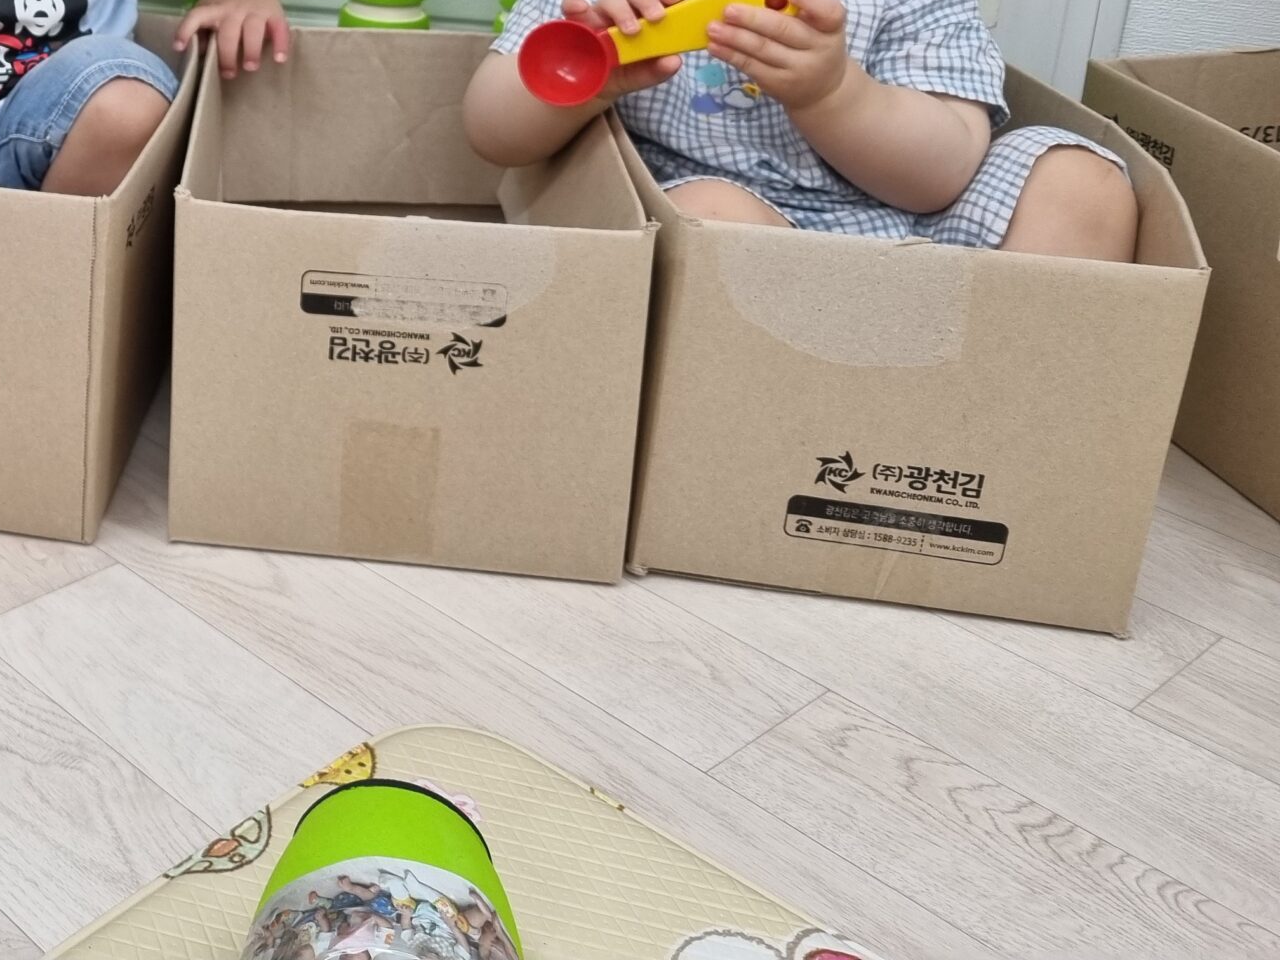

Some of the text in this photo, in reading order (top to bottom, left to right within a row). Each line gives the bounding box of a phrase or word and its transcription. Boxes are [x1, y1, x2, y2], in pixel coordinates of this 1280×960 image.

[328, 335, 431, 365] (주)광천김
[826, 466, 849, 479] KC
[871, 463, 986, 499] (주)광천김
[870, 486, 944, 505] KWANGCHEONKIM
[964, 499, 981, 510] LTD.
[815, 525, 841, 537] 소비자
[842, 527, 867, 540] 상담실
[872, 532, 918, 547] 1588-9235
